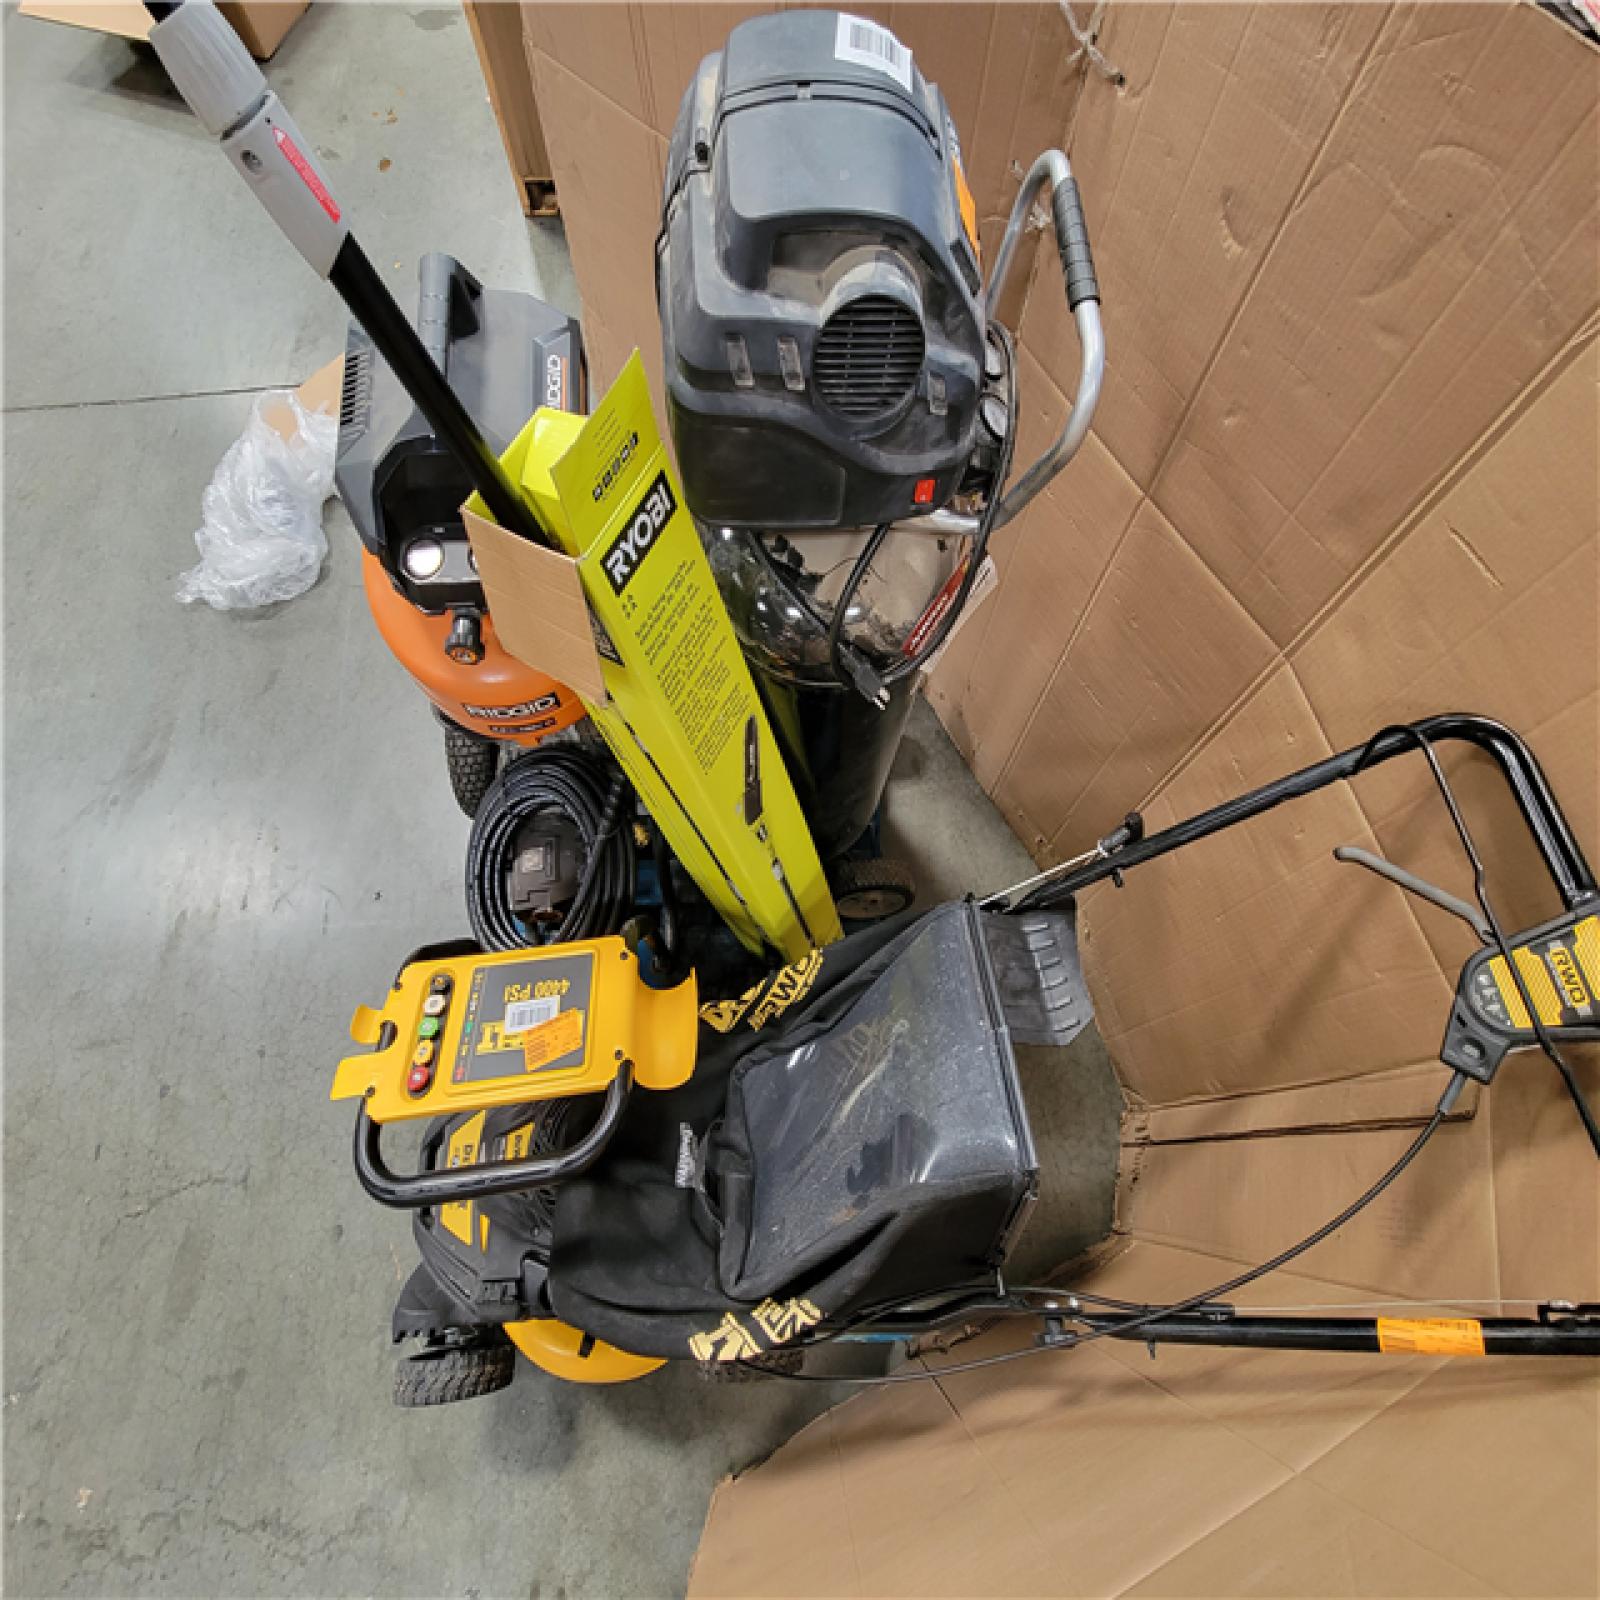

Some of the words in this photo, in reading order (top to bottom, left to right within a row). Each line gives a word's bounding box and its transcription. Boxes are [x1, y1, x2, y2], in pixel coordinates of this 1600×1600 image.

[546, 353, 562, 409] IDGID
[605, 483, 673, 586] RYOBI
[464, 696, 557, 719] RIDGID
[503, 983, 533, 1002] PSI
[1551, 948, 1587, 1004] RWD
